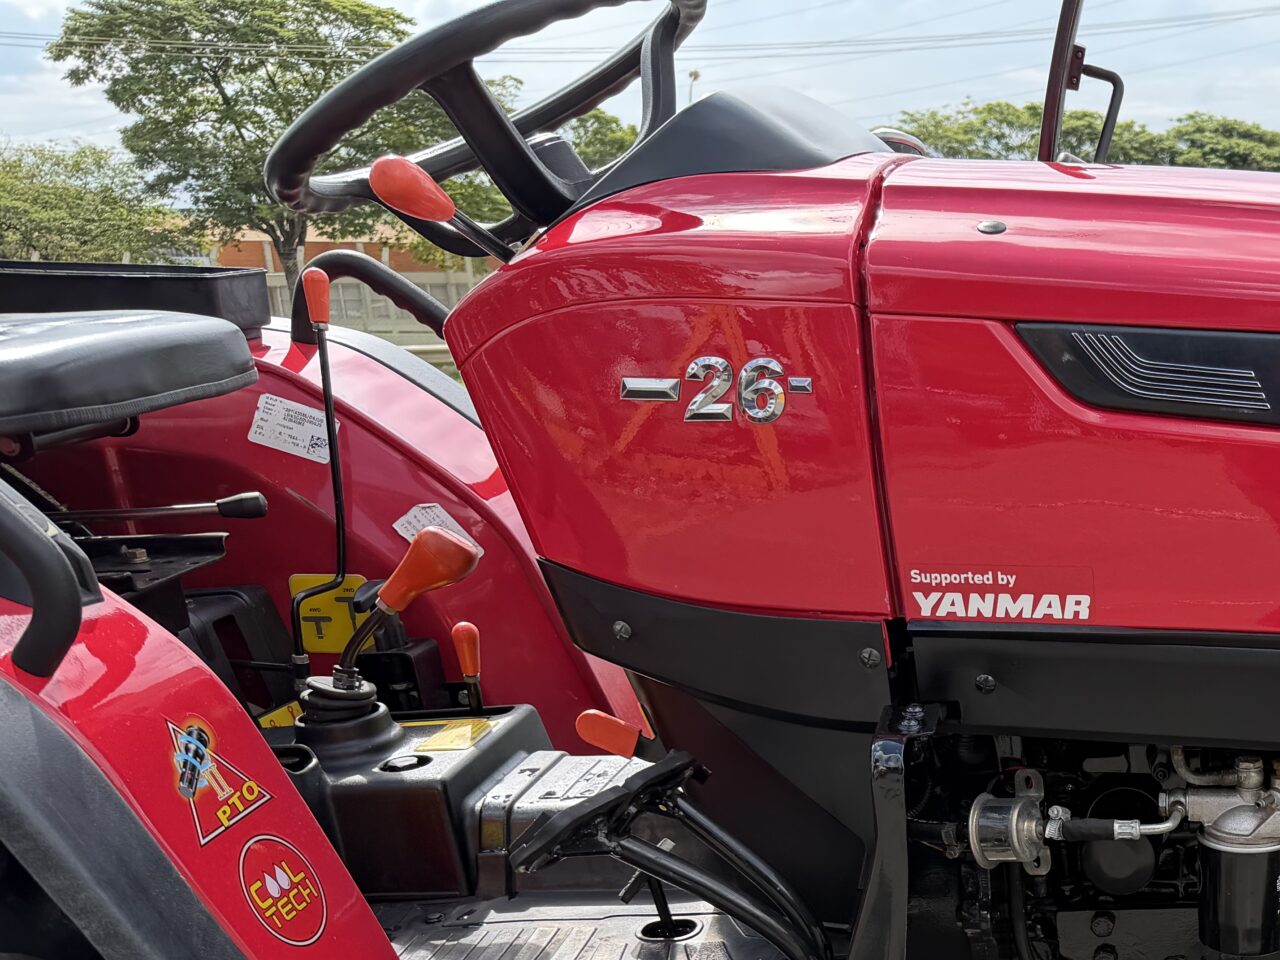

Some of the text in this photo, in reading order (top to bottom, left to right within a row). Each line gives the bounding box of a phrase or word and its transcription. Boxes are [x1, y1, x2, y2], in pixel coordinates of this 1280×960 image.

[683, 356, 786, 424] 26
[910, 569, 1017, 588] Supported by
[912, 591, 1091, 620] YANMAR
[216, 780, 260, 828] PTO
[264, 878, 319, 928] TECH
